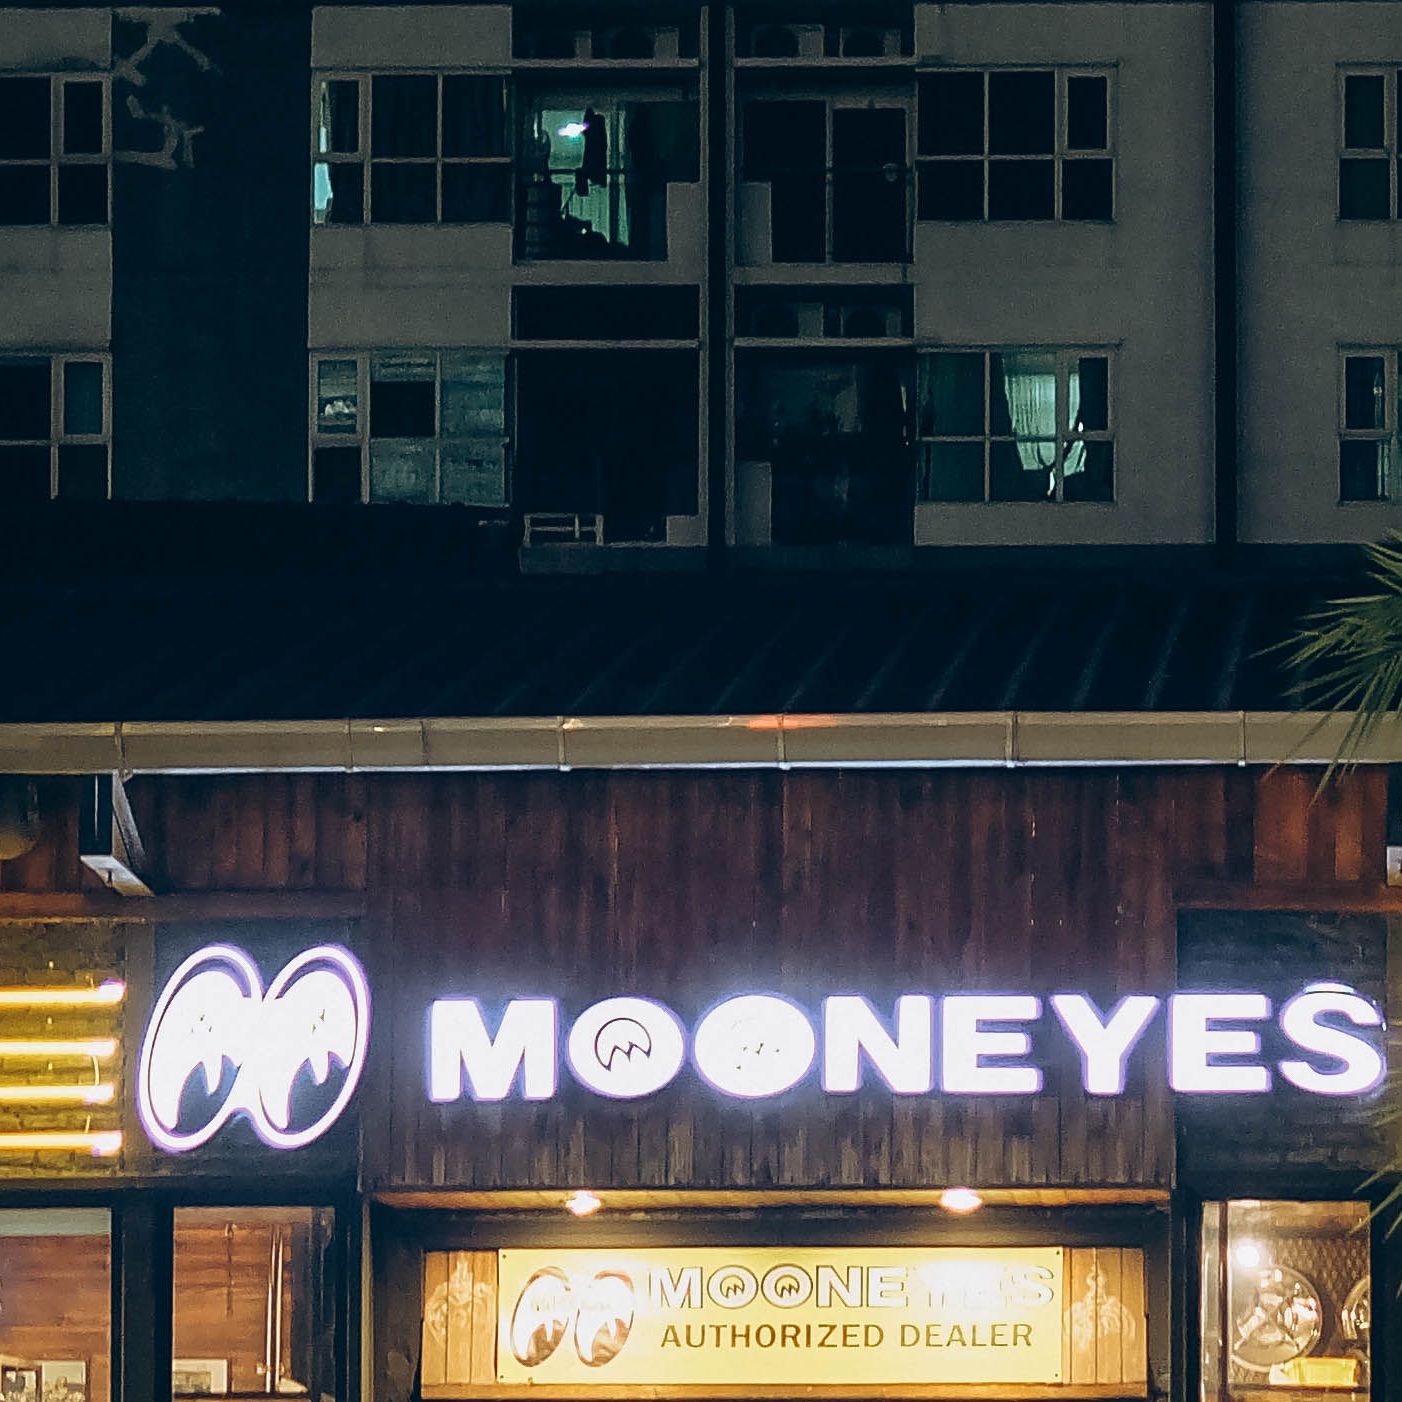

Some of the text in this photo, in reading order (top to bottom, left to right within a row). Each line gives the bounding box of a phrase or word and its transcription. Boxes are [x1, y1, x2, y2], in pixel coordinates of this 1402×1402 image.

[428, 981, 1387, 1102] MOONEYES
[660, 1322, 1033, 1349] AUTHORIZED DEALER
